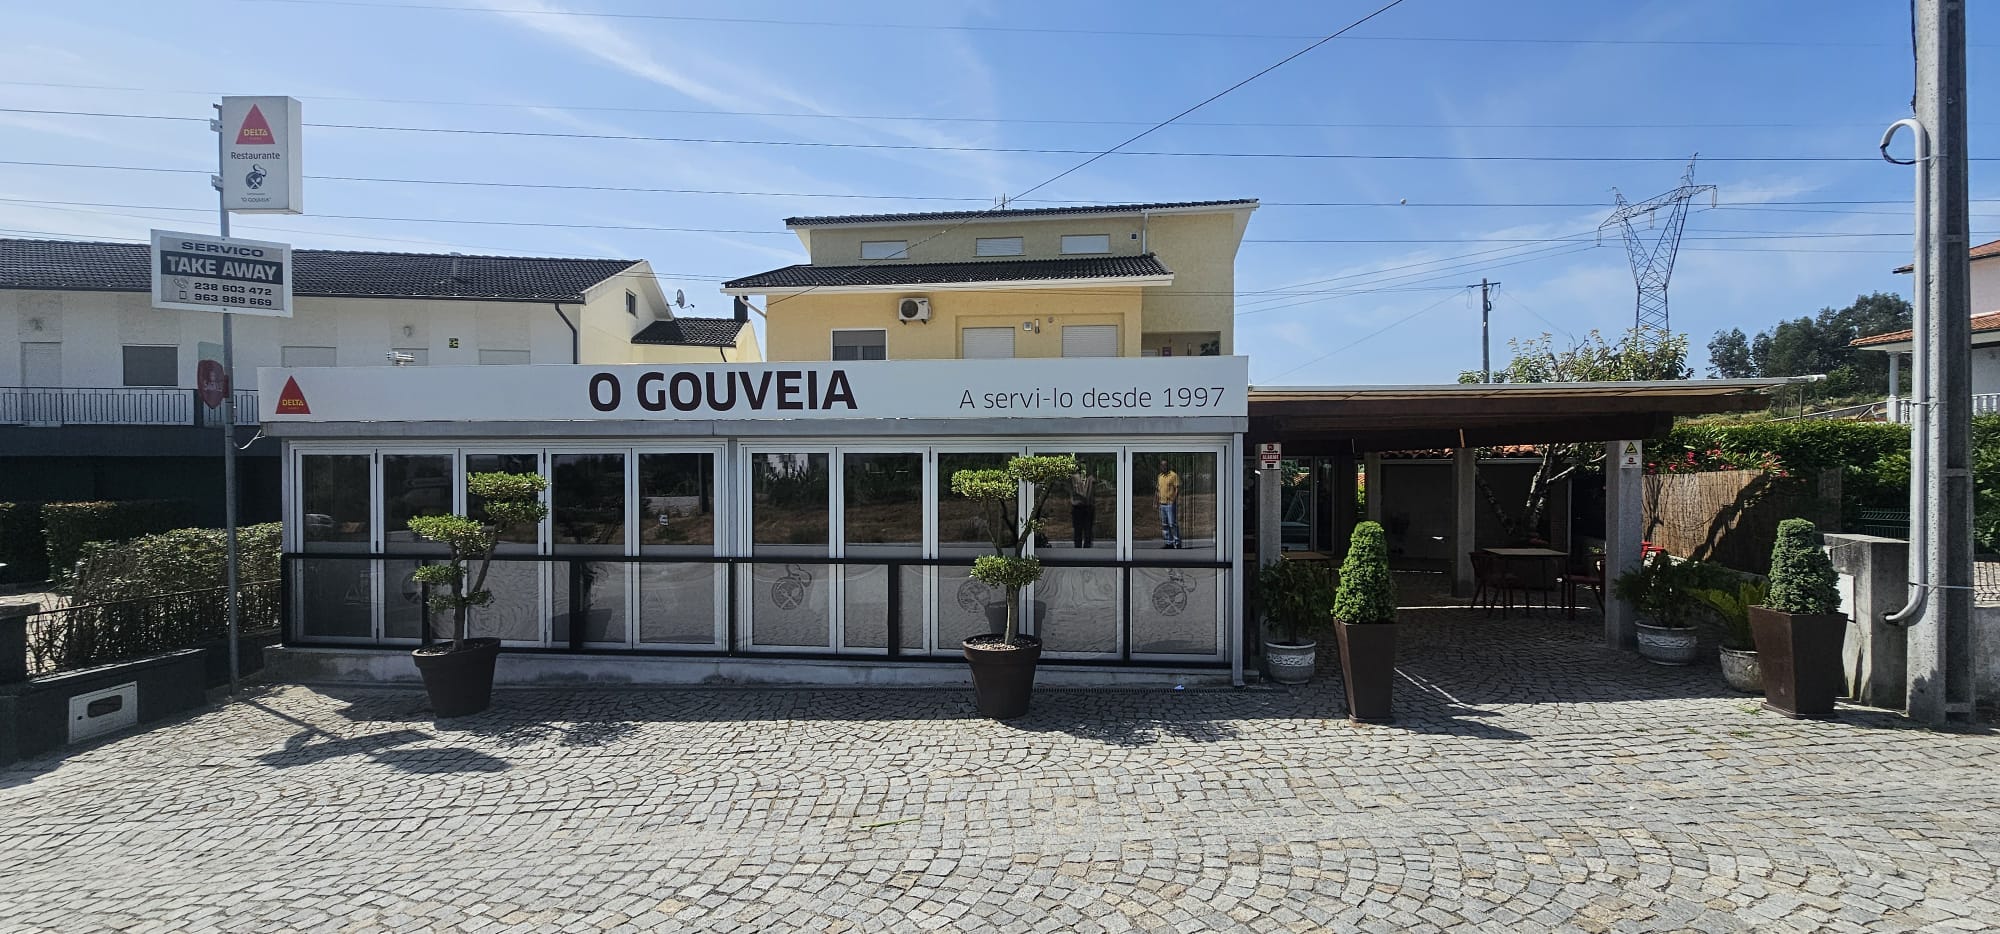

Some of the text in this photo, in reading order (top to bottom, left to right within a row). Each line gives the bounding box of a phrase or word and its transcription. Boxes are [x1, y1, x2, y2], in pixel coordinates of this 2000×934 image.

[243, 128, 269, 137] DELTA
[230, 151, 281, 160] Restaurante
[166, 255, 277, 281] TAKE AWAY
[194, 282, 273, 296] 238 603 472
[194, 293, 273, 306] 963 989 669
[588, 369, 859, 412] O GOUVEIA
[959, 386, 1226, 409] A servi-lo desde 1997
